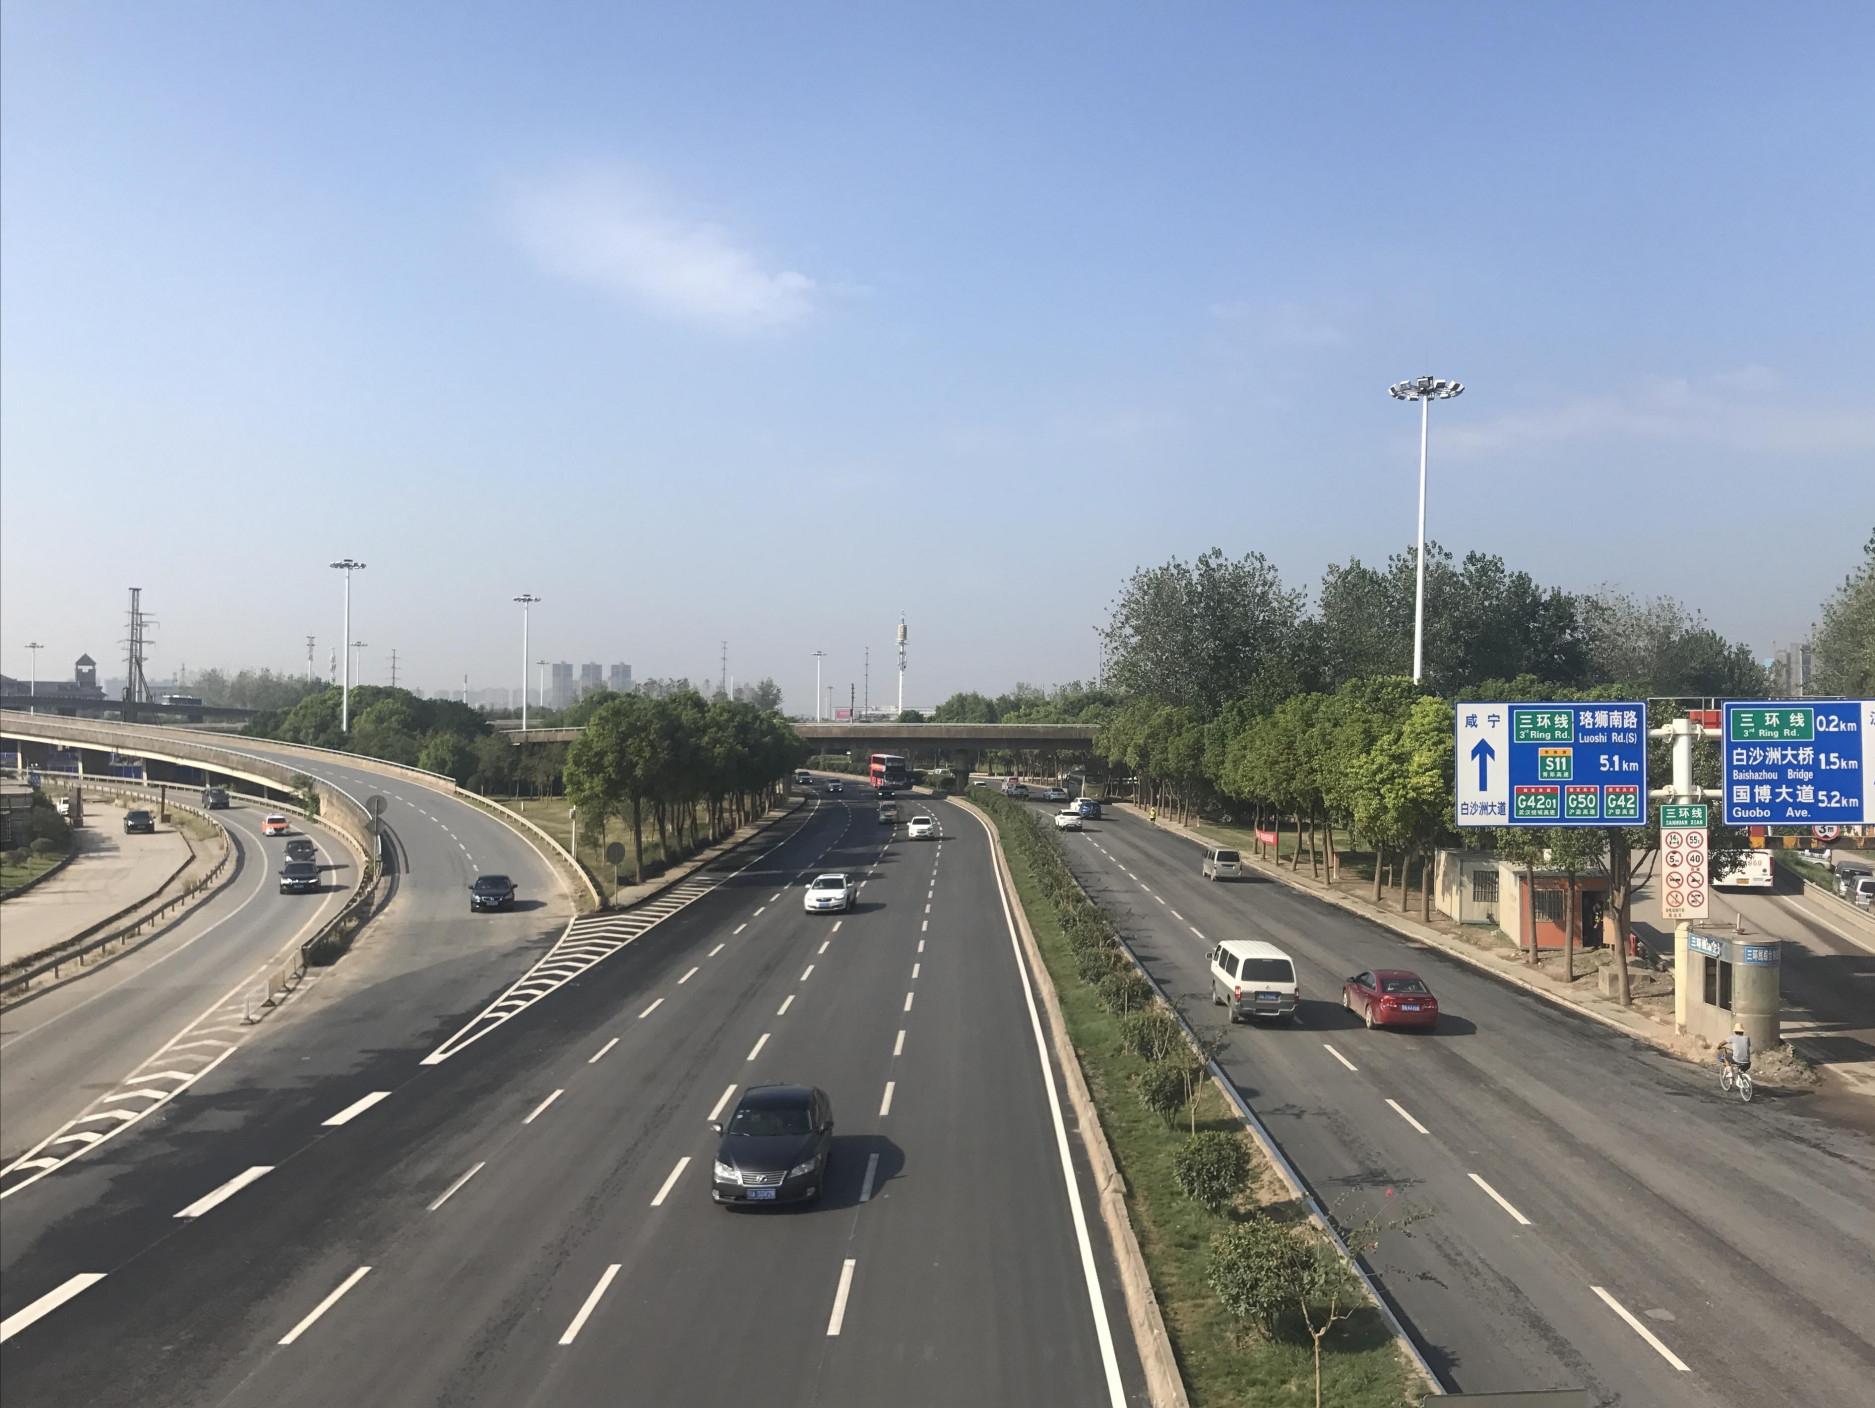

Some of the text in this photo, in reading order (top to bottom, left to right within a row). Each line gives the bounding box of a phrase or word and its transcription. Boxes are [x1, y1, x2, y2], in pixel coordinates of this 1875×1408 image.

[1465, 713, 1501, 728] 咸宁
[1519, 713, 1569, 728] 三环线
[1579, 710, 1638, 728] 珞狮南路
[1740, 712, 1805, 728] 三环线
[1530, 730, 1551, 740] Ring
[1555, 730, 1571, 739] Rd.
[1579, 732, 1637, 744] Luoshi Rd.(S)
[1759, 729, 1779, 738] Ring
[1783, 729, 1800, 737] Rd.
[1732, 747, 1815, 765] 白沙洲大桥
[1545, 757, 1567, 770] S11
[1732, 768, 1814, 781] Baishazhou Bridge
[1733, 785, 1815, 803] 国博大道
[1517, 795, 1557, 808] G4201
[1568, 794, 1596, 808] G50
[1607, 794, 1635, 808] G42
[1460, 801, 1506, 816] 白沙洲大道
[1666, 807, 1703, 819] 三环线
[1732, 807, 1811, 818] Guobo Ave.
[1689, 854, 1701, 863] 40
